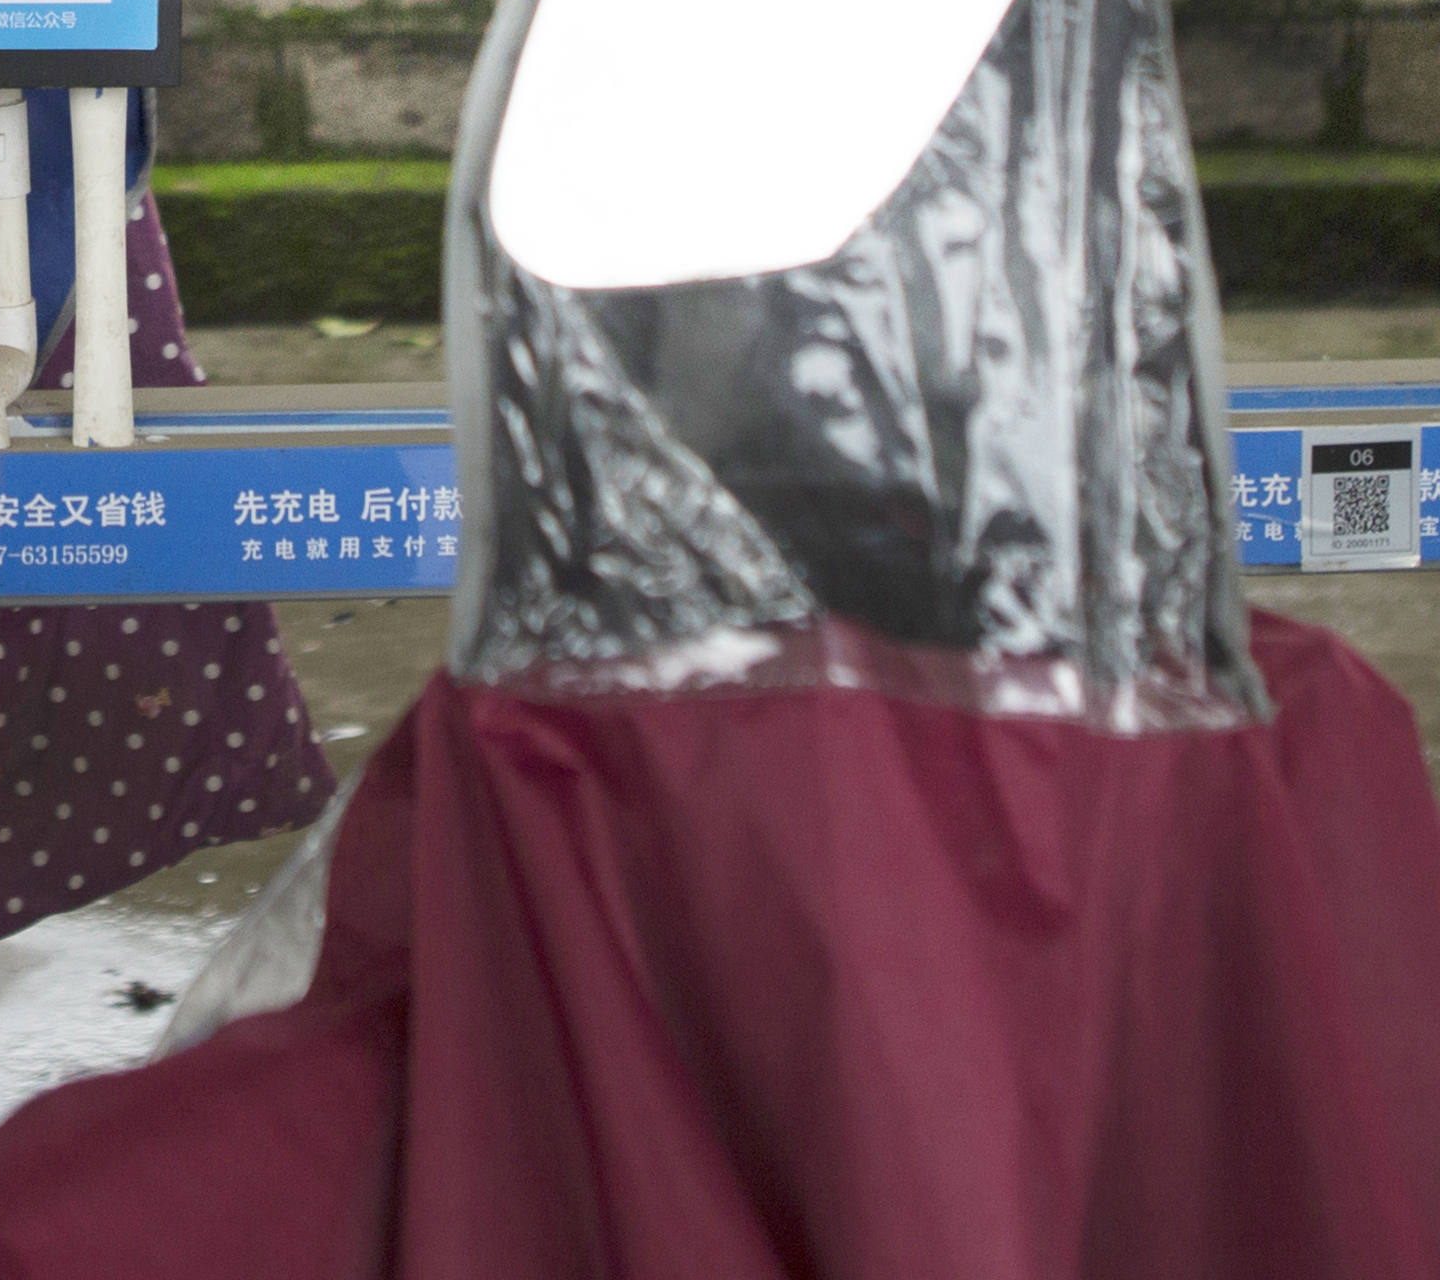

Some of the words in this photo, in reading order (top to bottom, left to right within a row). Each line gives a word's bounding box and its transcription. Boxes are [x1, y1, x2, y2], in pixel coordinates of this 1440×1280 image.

[1350, 449, 1374, 466] 06
[1229, 473, 1302, 507] 先充
[233, 488, 340, 526] 先充电
[360, 486, 465, 522] 后付款
[241, 534, 460, 561] 充电就用支付宝
